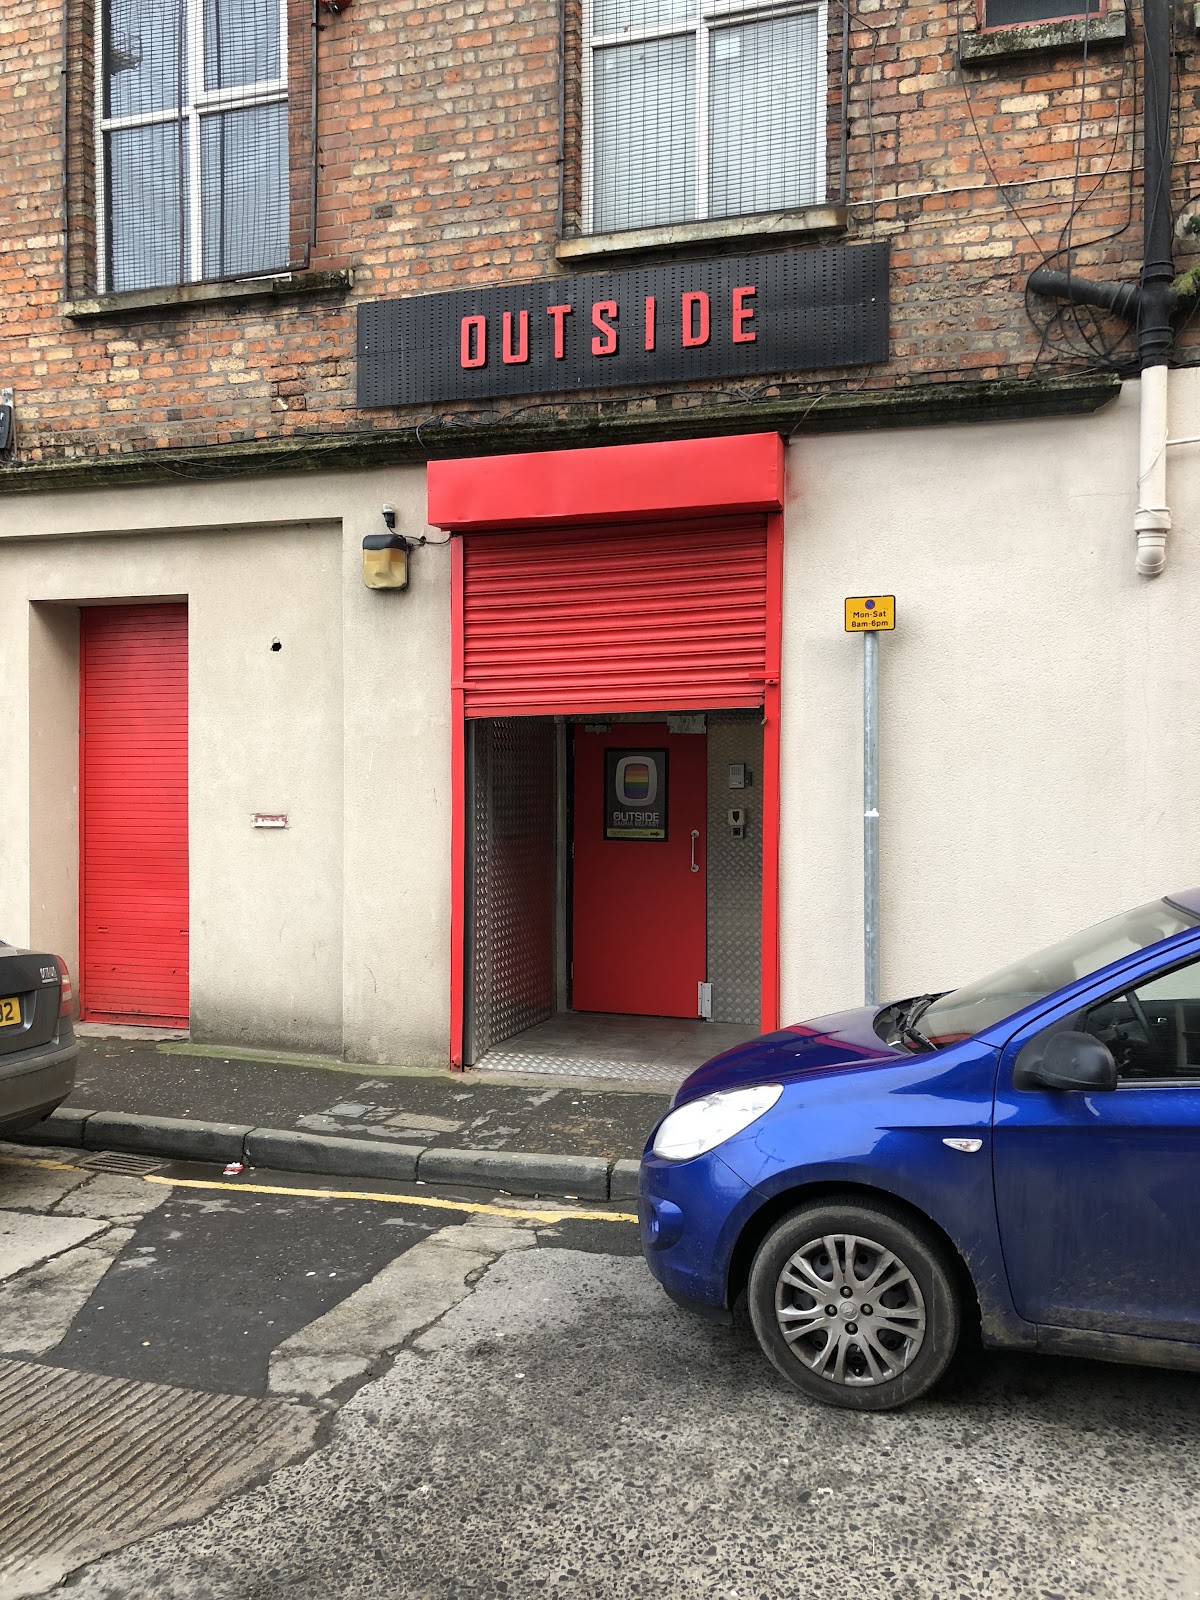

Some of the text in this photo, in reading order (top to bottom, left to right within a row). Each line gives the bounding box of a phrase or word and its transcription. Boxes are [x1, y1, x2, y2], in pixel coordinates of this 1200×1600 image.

[460, 286, 756, 369] OUTSIDE
[851, 620, 889, 628] 8am-6pm
[613, 811, 660, 821] OUTSIDE
